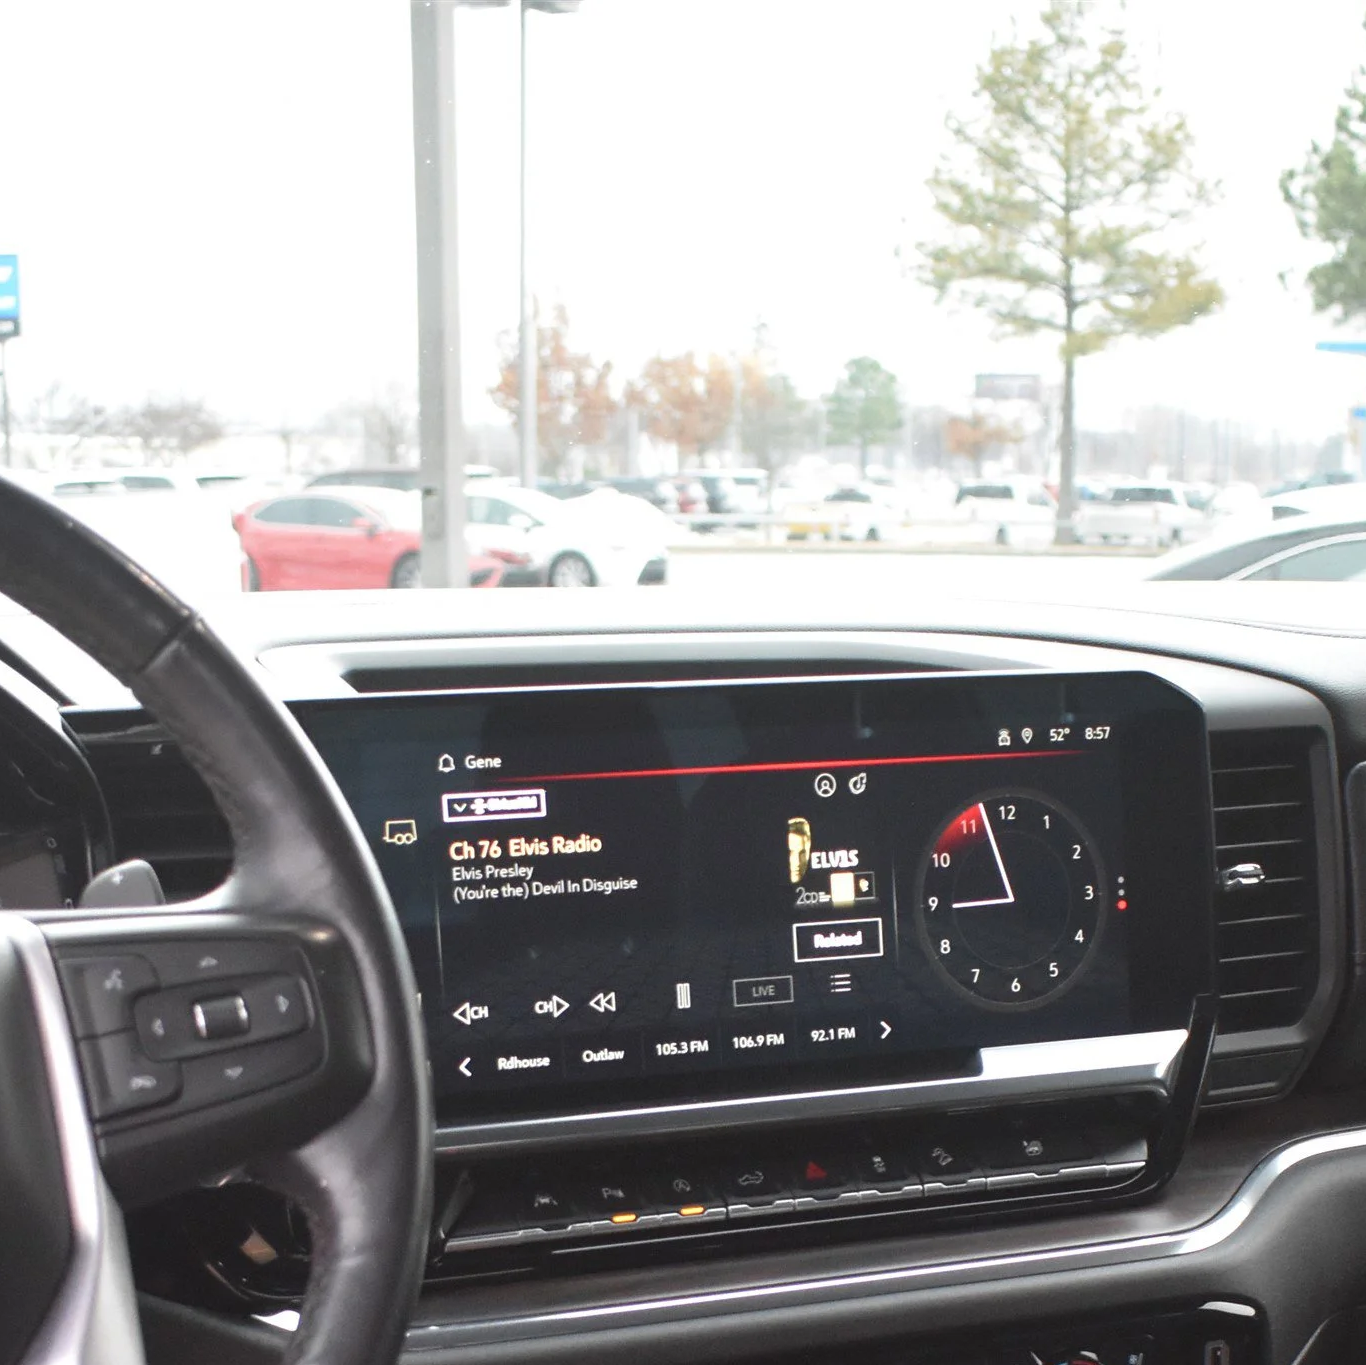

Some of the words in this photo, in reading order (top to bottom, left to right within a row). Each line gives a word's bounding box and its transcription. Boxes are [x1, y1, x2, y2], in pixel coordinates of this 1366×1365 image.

[1049, 728, 1071, 741] 52°
[1085, 727, 1111, 740] 8:57
[464, 754, 502, 769] Gene
[998, 805, 1016, 820] 12
[960, 819, 977, 834] 11
[1043, 815, 1050, 829] 1
[449, 840, 475, 861] Ch
[478, 839, 502, 859] 76
[509, 836, 549, 857] Elvis
[552, 833, 602, 854] Radio
[1072, 845, 1081, 859] 2
[932, 853, 951, 867] 10
[452, 866, 483, 881] Elvis
[485, 863, 534, 884] Presley
[453, 885, 499, 904] (You're
[501, 882, 530, 900] the)
[532, 880, 565, 896] Devil
[567, 880, 580, 894] In
[582, 876, 638, 894] Disguise
[1084, 886, 1094, 900] 3
[928, 897, 939, 911] 9
[813, 930, 863, 949] Related
[1074, 929, 1084, 943] 4
[940, 940, 951, 954] 8
[971, 969, 981, 983] 7
[1049, 963, 1059, 977] 5
[752, 984, 776, 998] LIVE
[1011, 979, 1021, 992] 6
[471, 1004, 489, 1019] CH
[535, 1000, 553, 1015] CH
[733, 1034, 764, 1049] 106.9
[766, 1033, 785, 1046] FM
[811, 1028, 835, 1042] 92.1
[837, 1027, 856, 1040] FM
[582, 1048, 625, 1063] Outlaw
[656, 1041, 688, 1056] 105.3
[690, 1040, 709, 1054] FM
[498, 1055, 550, 1071] Rdhouse
